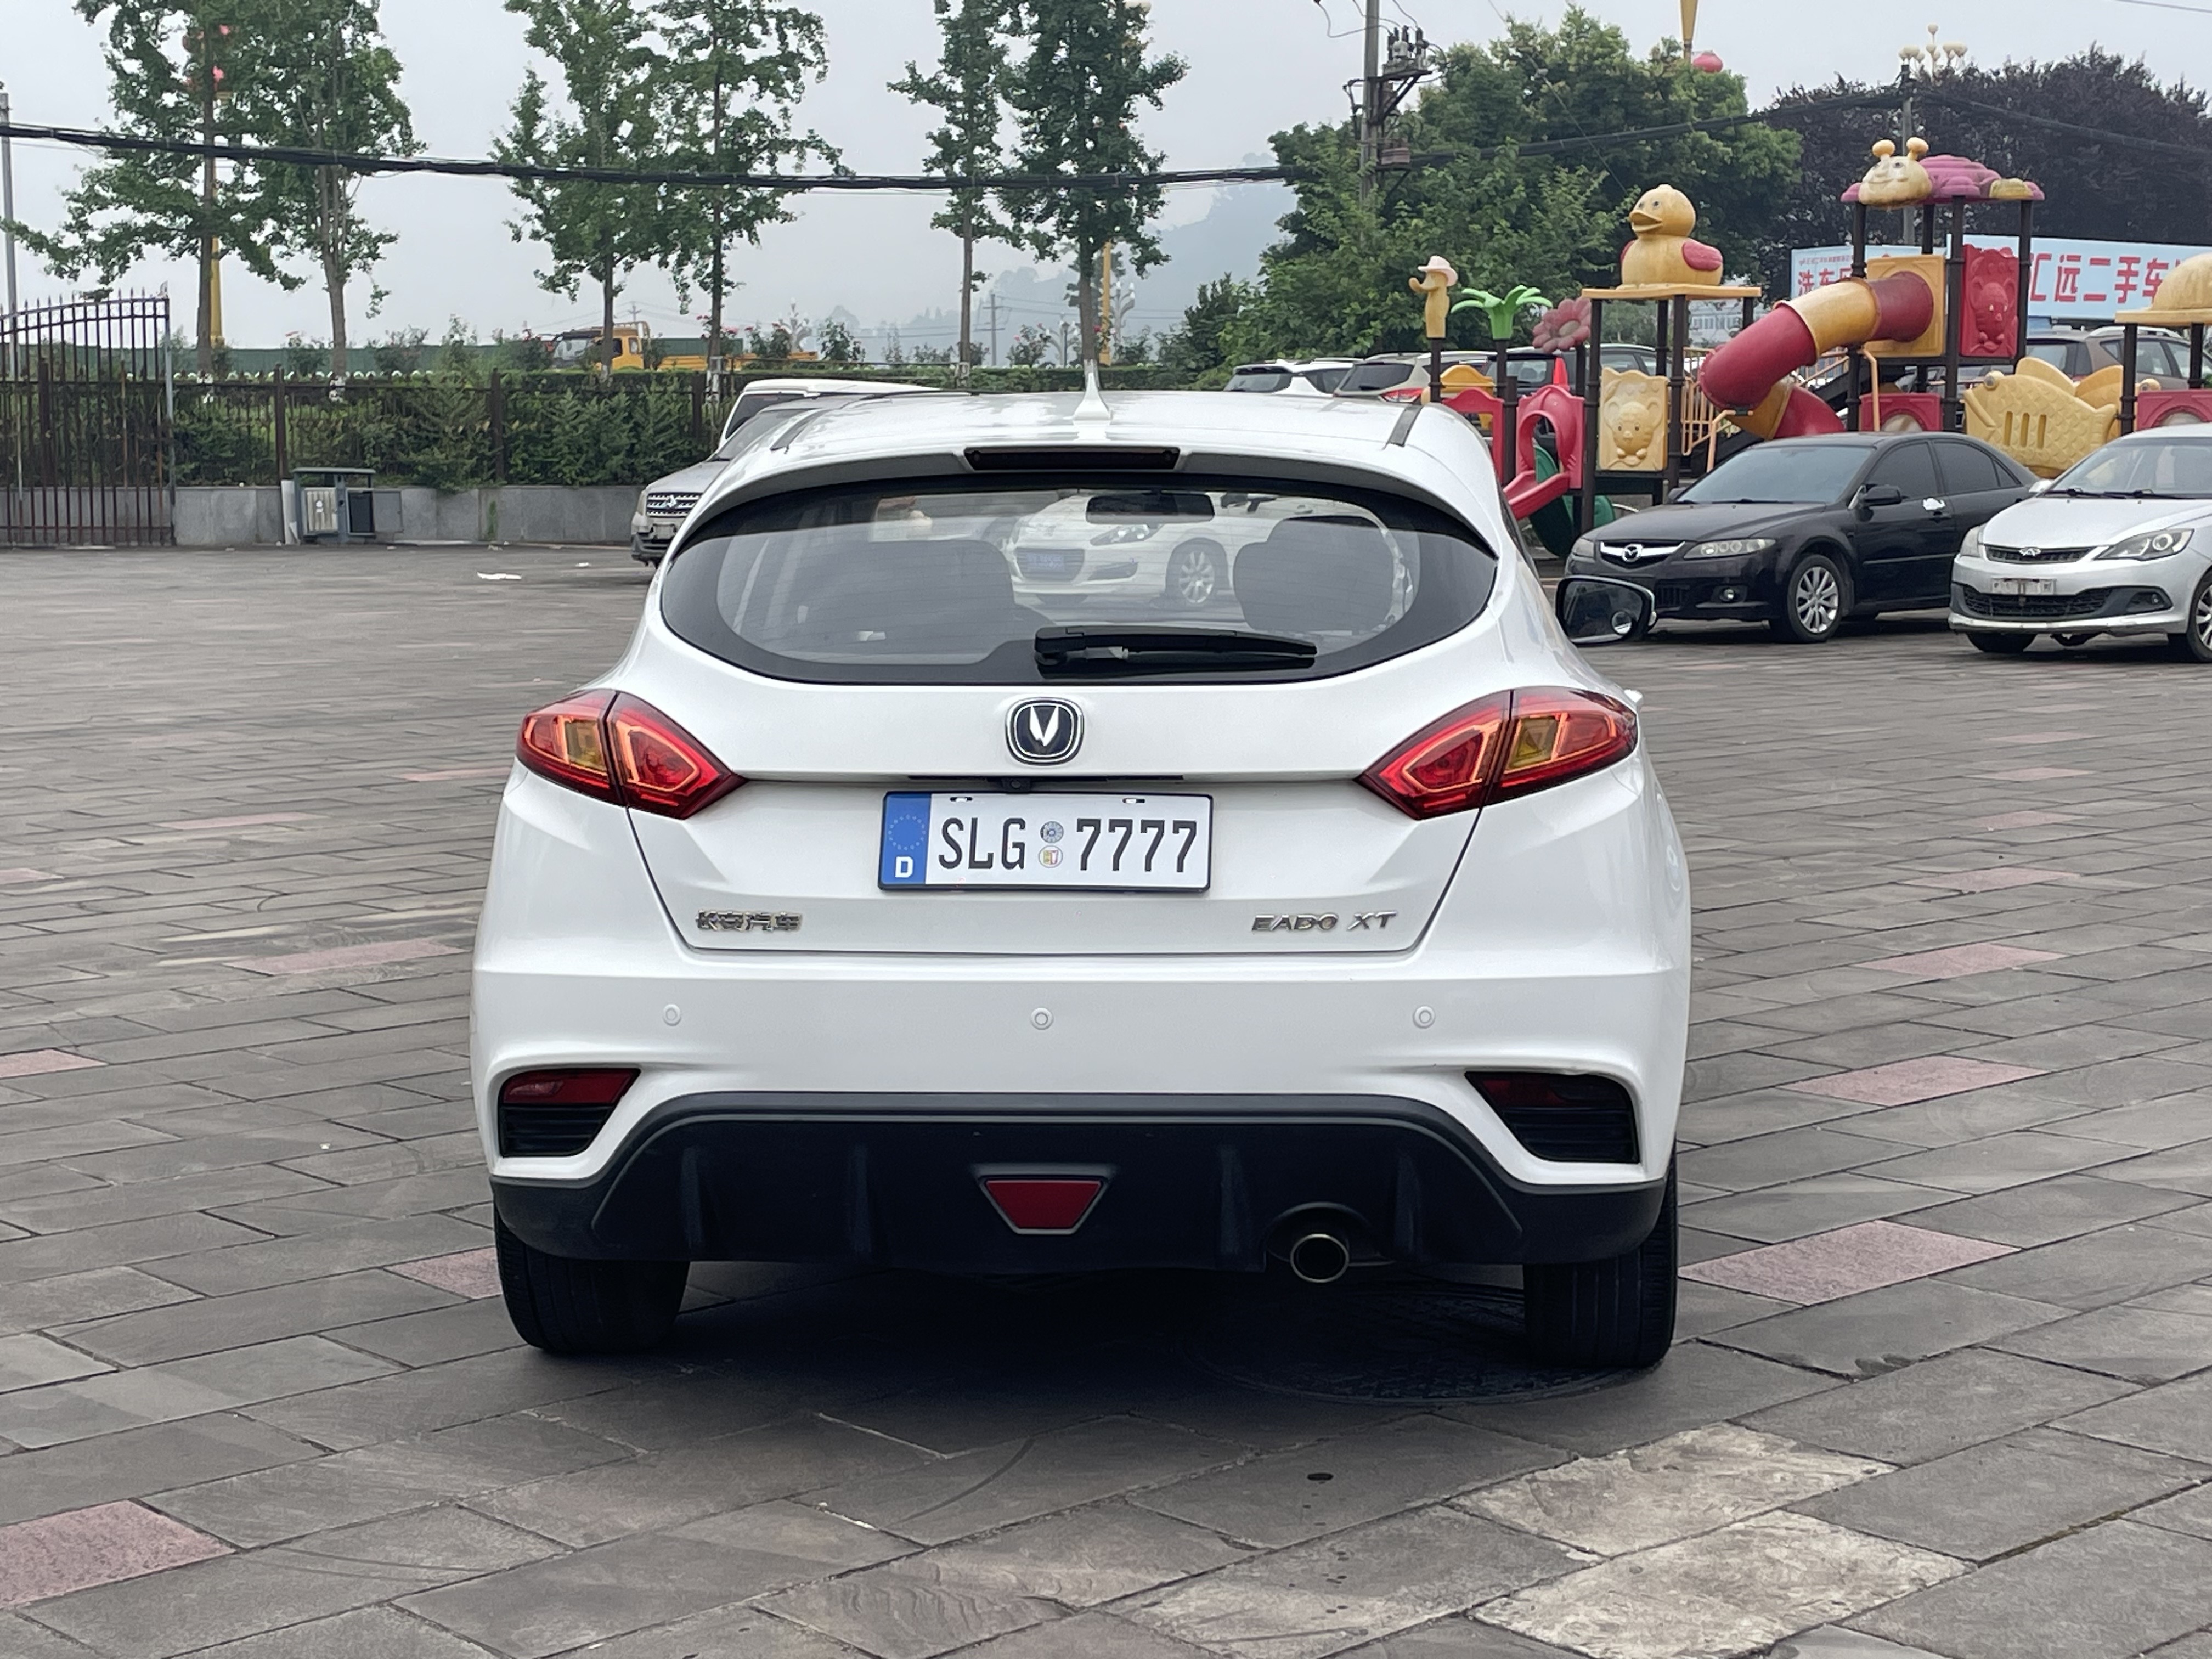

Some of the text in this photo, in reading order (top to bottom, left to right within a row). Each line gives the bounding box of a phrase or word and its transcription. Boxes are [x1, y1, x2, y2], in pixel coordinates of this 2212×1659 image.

[1798, 268, 1852, 296] 洗车
[2030, 253, 2180, 304] 汇远二手车
[939, 817, 1197, 873] SLG 7777
[895, 856, 913, 878] D
[1251, 911, 1397, 932] EADO XT
